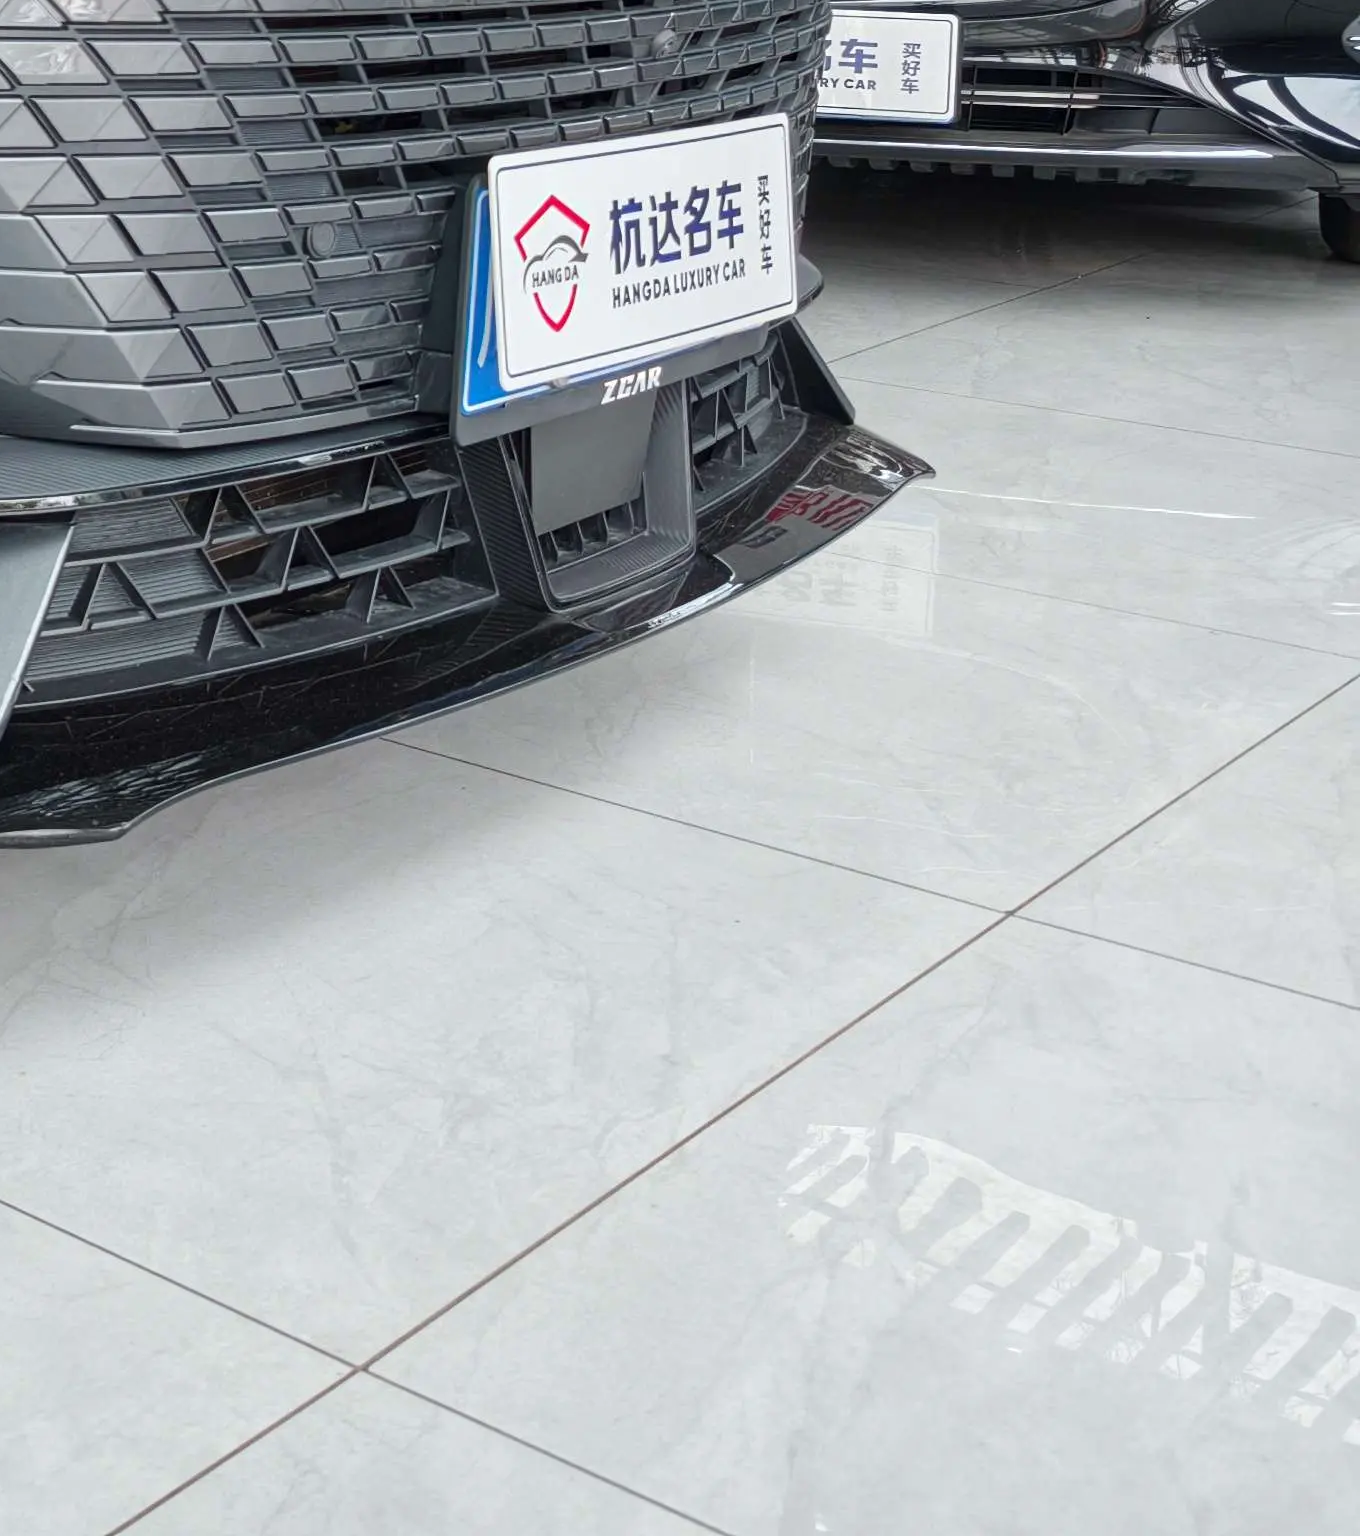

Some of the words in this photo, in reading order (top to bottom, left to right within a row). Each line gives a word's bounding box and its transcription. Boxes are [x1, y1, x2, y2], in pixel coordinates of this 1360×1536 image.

[824, 38, 879, 74] 车
[900, 42, 922, 94] 买好车
[843, 78, 877, 90] CAR
[609, 179, 745, 275] 杭达名车
[757, 174, 771, 275] 买好车
[532, 268, 563, 289] HANG
[564, 264, 580, 281] DA
[612, 280, 672, 309] HANGDA
[674, 264, 720, 294] LUXURY
[722, 258, 746, 281] CAR
